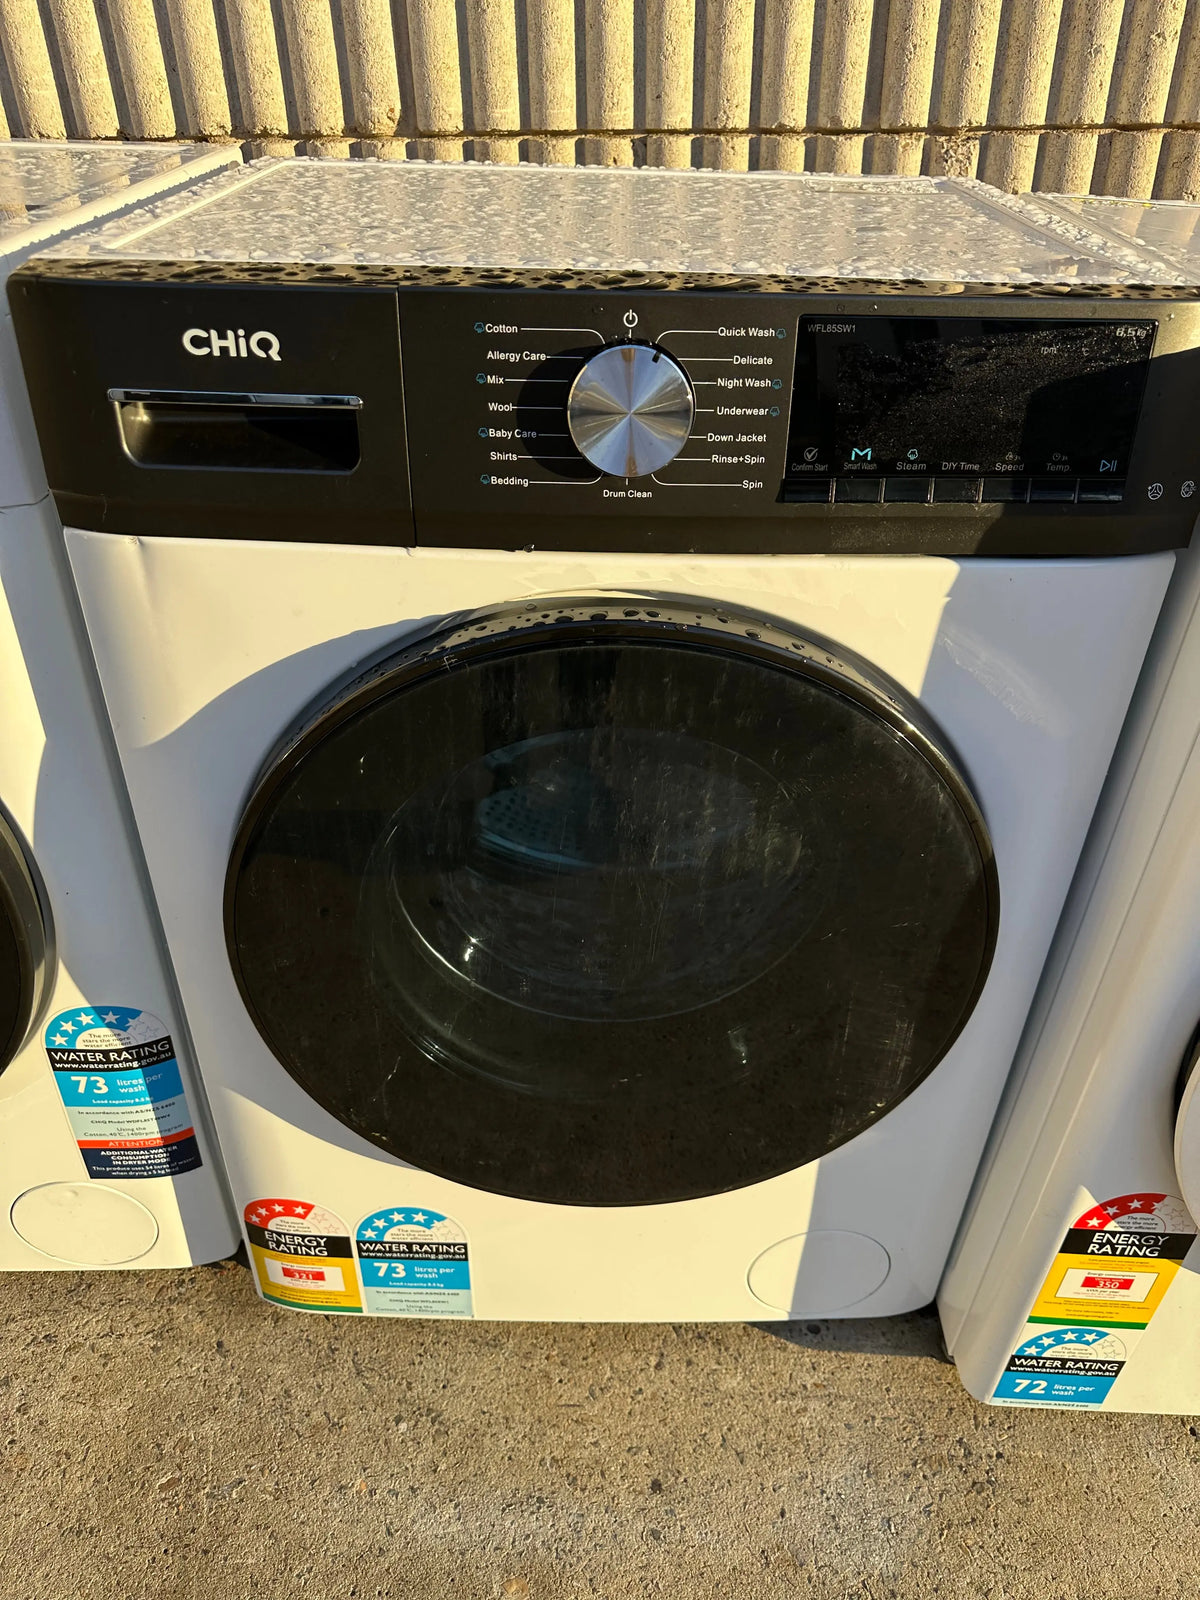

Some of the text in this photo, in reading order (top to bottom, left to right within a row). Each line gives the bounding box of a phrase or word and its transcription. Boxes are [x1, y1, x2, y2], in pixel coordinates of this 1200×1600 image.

[485, 324, 518, 333] Cotton
[717, 327, 776, 337] Quick Wash
[807, 324, 856, 333] WFL85SW1
[182, 328, 282, 361] CHiQ
[487, 351, 547, 363] Allergy Care
[733, 355, 773, 365] Delicate
[487, 375, 505, 385] Mix
[717, 378, 772, 389] Night Wash
[488, 402, 513, 412] Wool
[716, 406, 769, 416] Underwear
[488, 429, 537, 438] Baby Care
[707, 432, 767, 442] Down Jacket
[490, 451, 518, 461] Shirts
[711, 454, 765, 465] Rinse+Spin
[792, 463, 828, 472] Confirm Start
[843, 462, 878, 470] Smart Wash
[896, 462, 927, 470] Steam
[941, 462, 980, 471] DIY Time
[995, 462, 1025, 472] Speed
[490, 476, 529, 487] Bedding
[742, 480, 763, 490] Spin
[603, 489, 653, 498] Drum Clean
[51, 1041, 170, 1062] WATER RATING
[55, 1052, 171, 1069] www.waterrating.gov.au
[70, 1076, 109, 1094] 73
[145, 1073, 163, 1083] per
[109, 1139, 165, 1147] ATTENTION
[264, 1230, 327, 1246] ENERGY
[1092, 1232, 1170, 1246] ENERGY
[268, 1241, 328, 1256] RATING
[360, 1242, 465, 1253] WATER RATING
[1087, 1243, 1161, 1257] RATING
[361, 1251, 466, 1259] www.waterrating.gov.au
[373, 1262, 406, 1278] 73
[1096, 1281, 1120, 1289] 350
[1014, 1358, 1119, 1371] WATER RATING
[1010, 1366, 1115, 1376] www.waterrating.gov.au
[1013, 1379, 1048, 1394] 72
